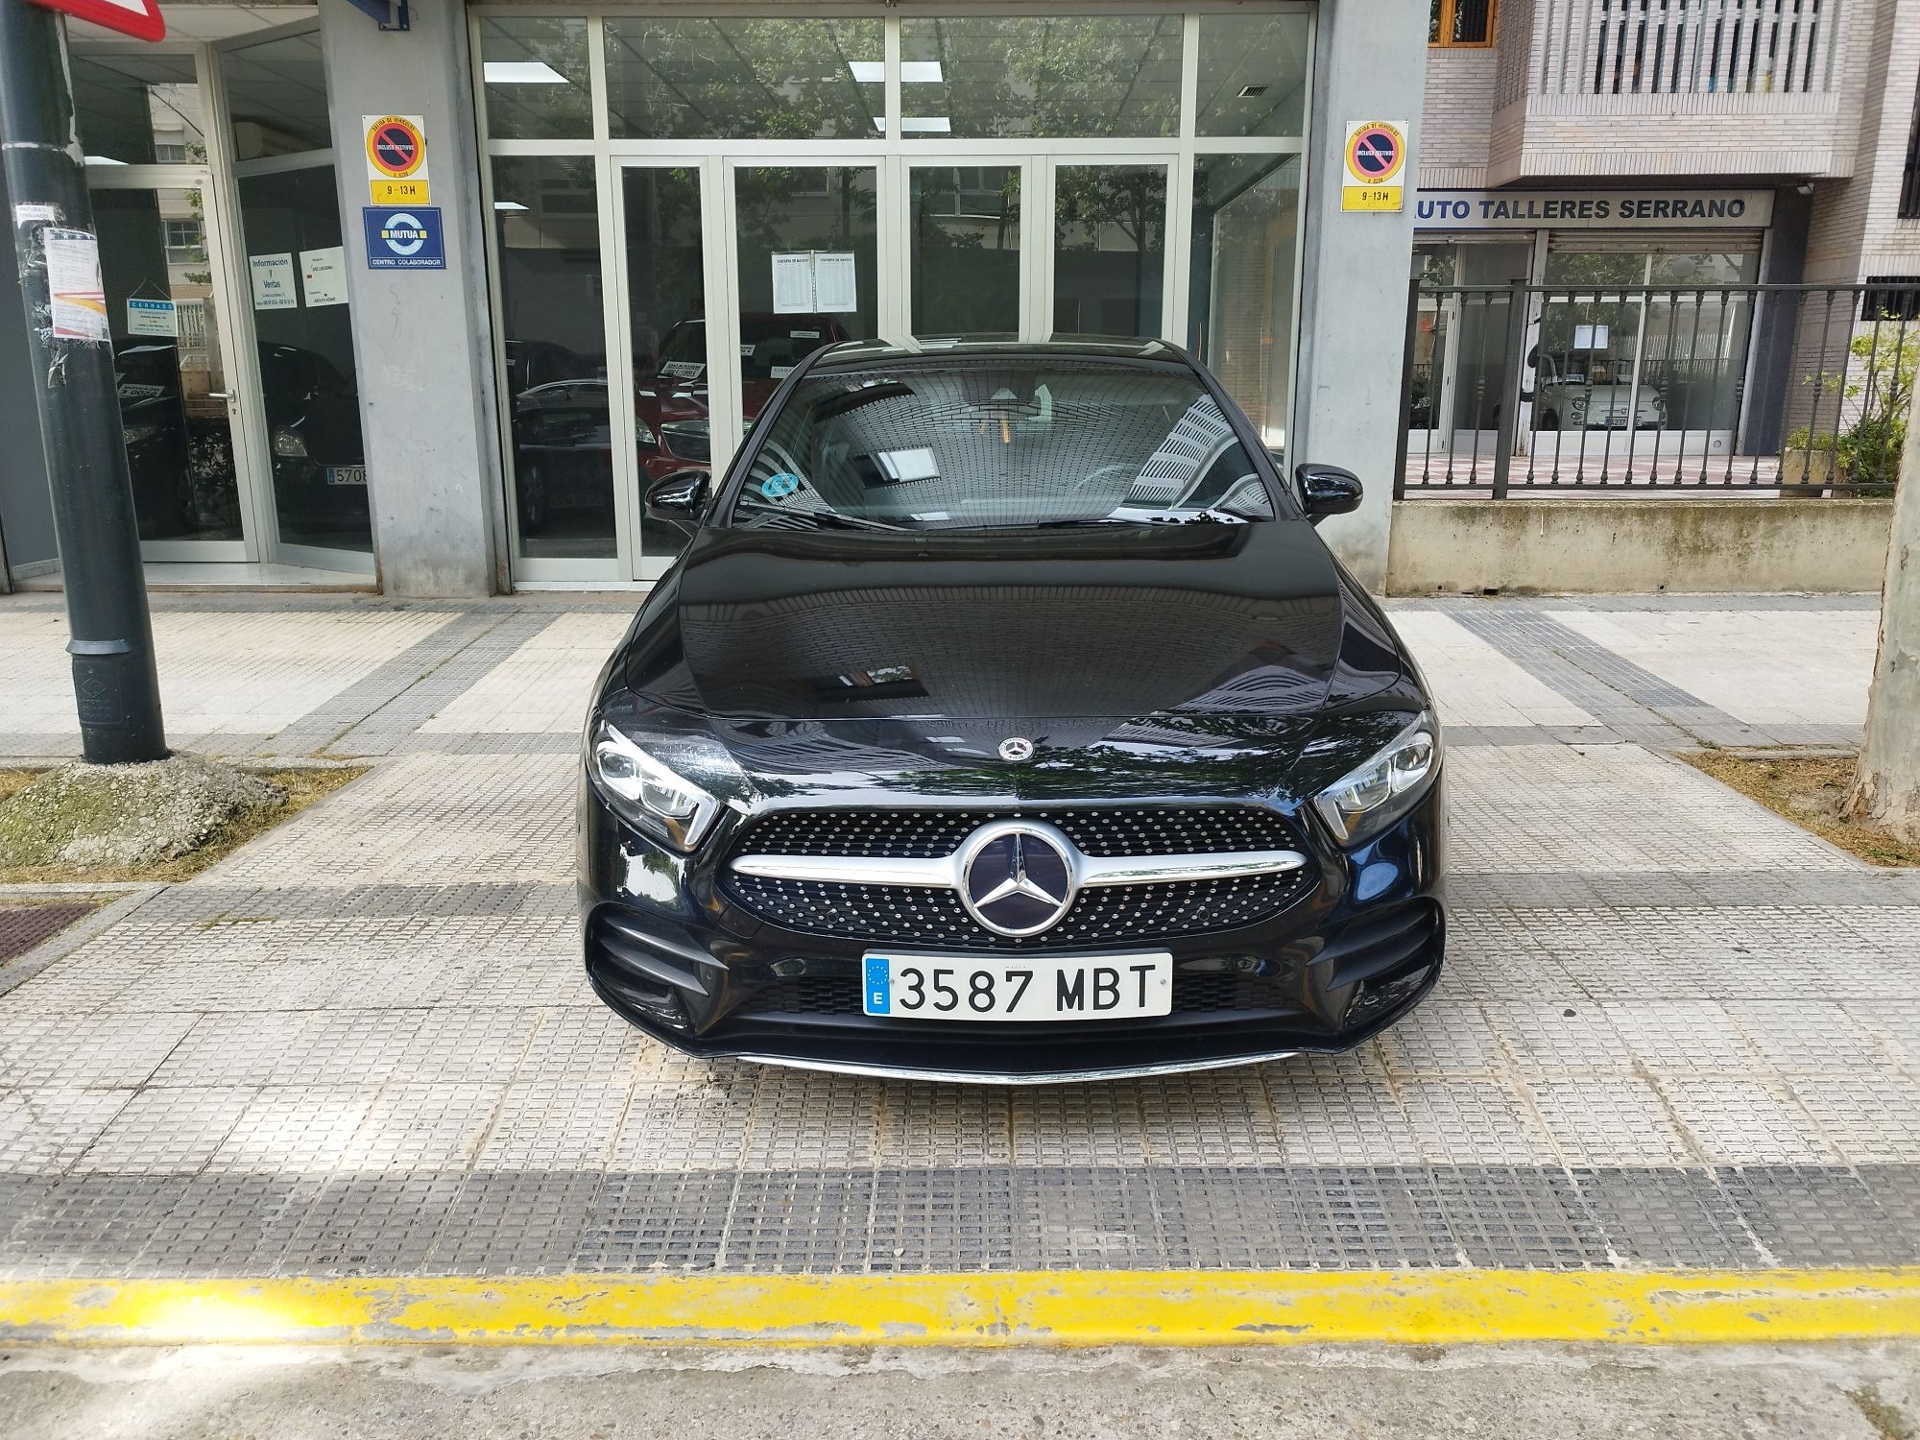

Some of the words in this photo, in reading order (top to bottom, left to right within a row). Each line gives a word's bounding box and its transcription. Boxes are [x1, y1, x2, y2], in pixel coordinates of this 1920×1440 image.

[1414, 200, 1471, 219] UTO
[1478, 200, 1611, 219] TALLERES
[1618, 199, 1746, 219] SERRANO
[390, 230, 419, 239] MUTUA
[252, 258, 288, 268] Información
[264, 280, 281, 289] Ventas
[899, 967, 1034, 1013] 3587
[1055, 964, 1156, 1012] MBT
[873, 992, 883, 1005] E
